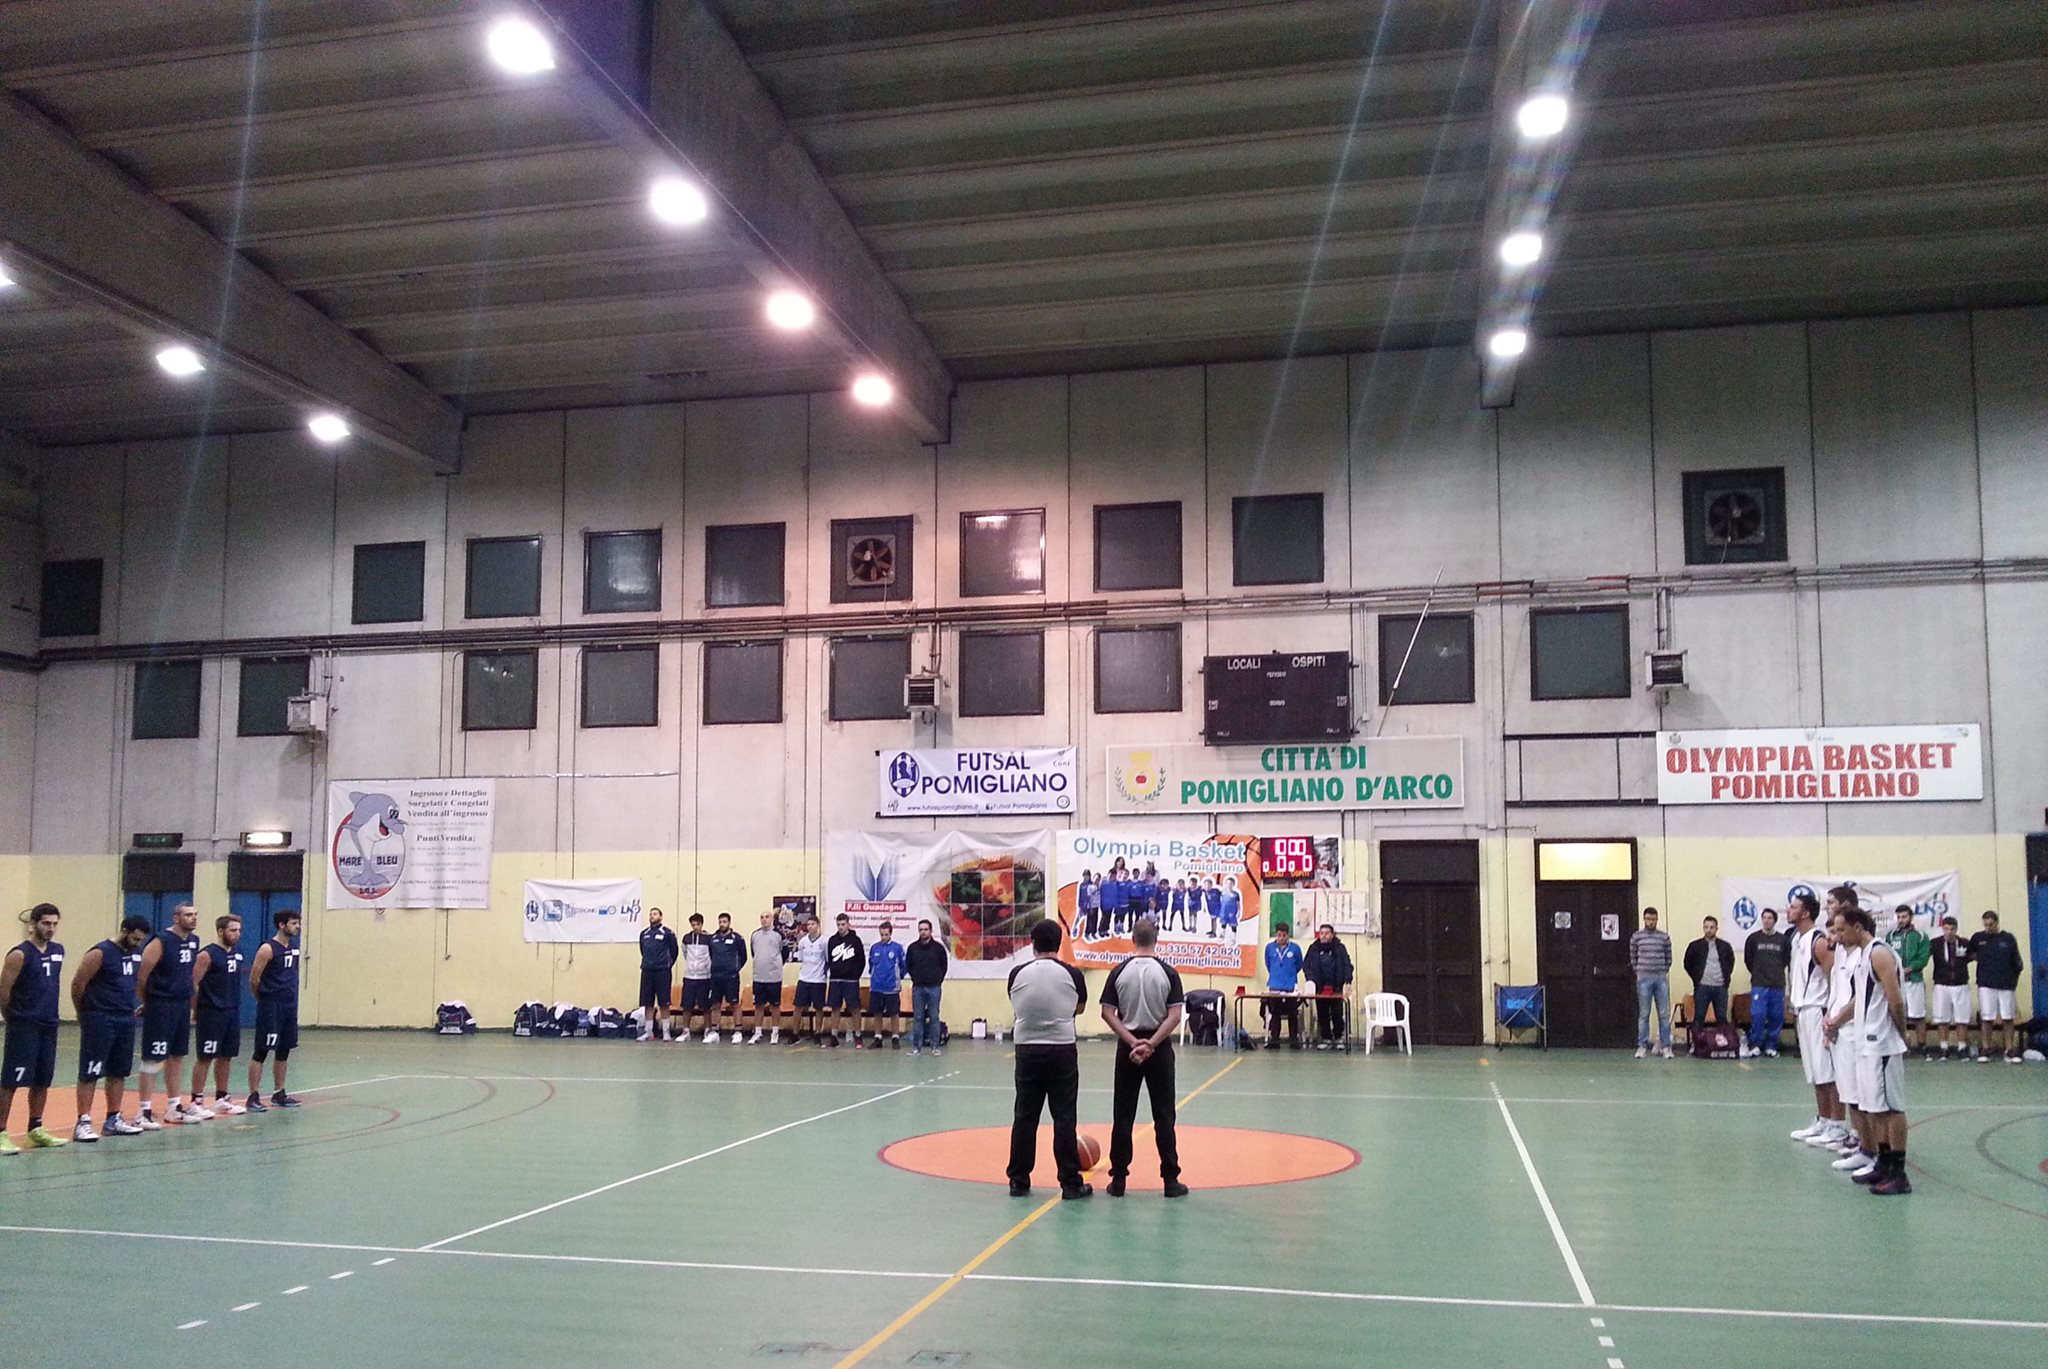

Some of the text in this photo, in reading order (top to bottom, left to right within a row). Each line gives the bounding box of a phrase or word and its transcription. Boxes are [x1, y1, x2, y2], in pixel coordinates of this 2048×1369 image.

[1227, 658, 1261, 670] LOCALI
[1292, 656, 1326, 668] OSPITI
[957, 752, 1031, 772] FUTSAL
[1341, 746, 1366, 769] DI
[1666, 742, 1957, 774] OLYMPIA BASKET
[922, 773, 1067, 795] POMIGLIANO
[1181, 774, 1453, 805] POMIGLIANO D'ARCO
[1711, 772, 1920, 800] POMIGLIANO
[410, 790, 443, 798] Ingrosso
[416, 834, 440, 842] Punti
[1074, 837, 1246, 860] Olympia Basket
[339, 857, 362, 866] MARE
[1174, 861, 1244, 874] Pomigliano
[863, 903, 905, 912] Guadagno
[179, 949, 192, 963] 33
[284, 954, 294, 967] 17
[42, 962, 51, 977] 7
[122, 961, 134, 975] 14
[227, 959, 237, 973] 21
[203, 1040, 217, 1053] 21
[266, 1034, 278, 1046] 17
[151, 1041, 168, 1054] 33
[15, 1067, 26, 1082] 7
[88, 1061, 102, 1075] 14
